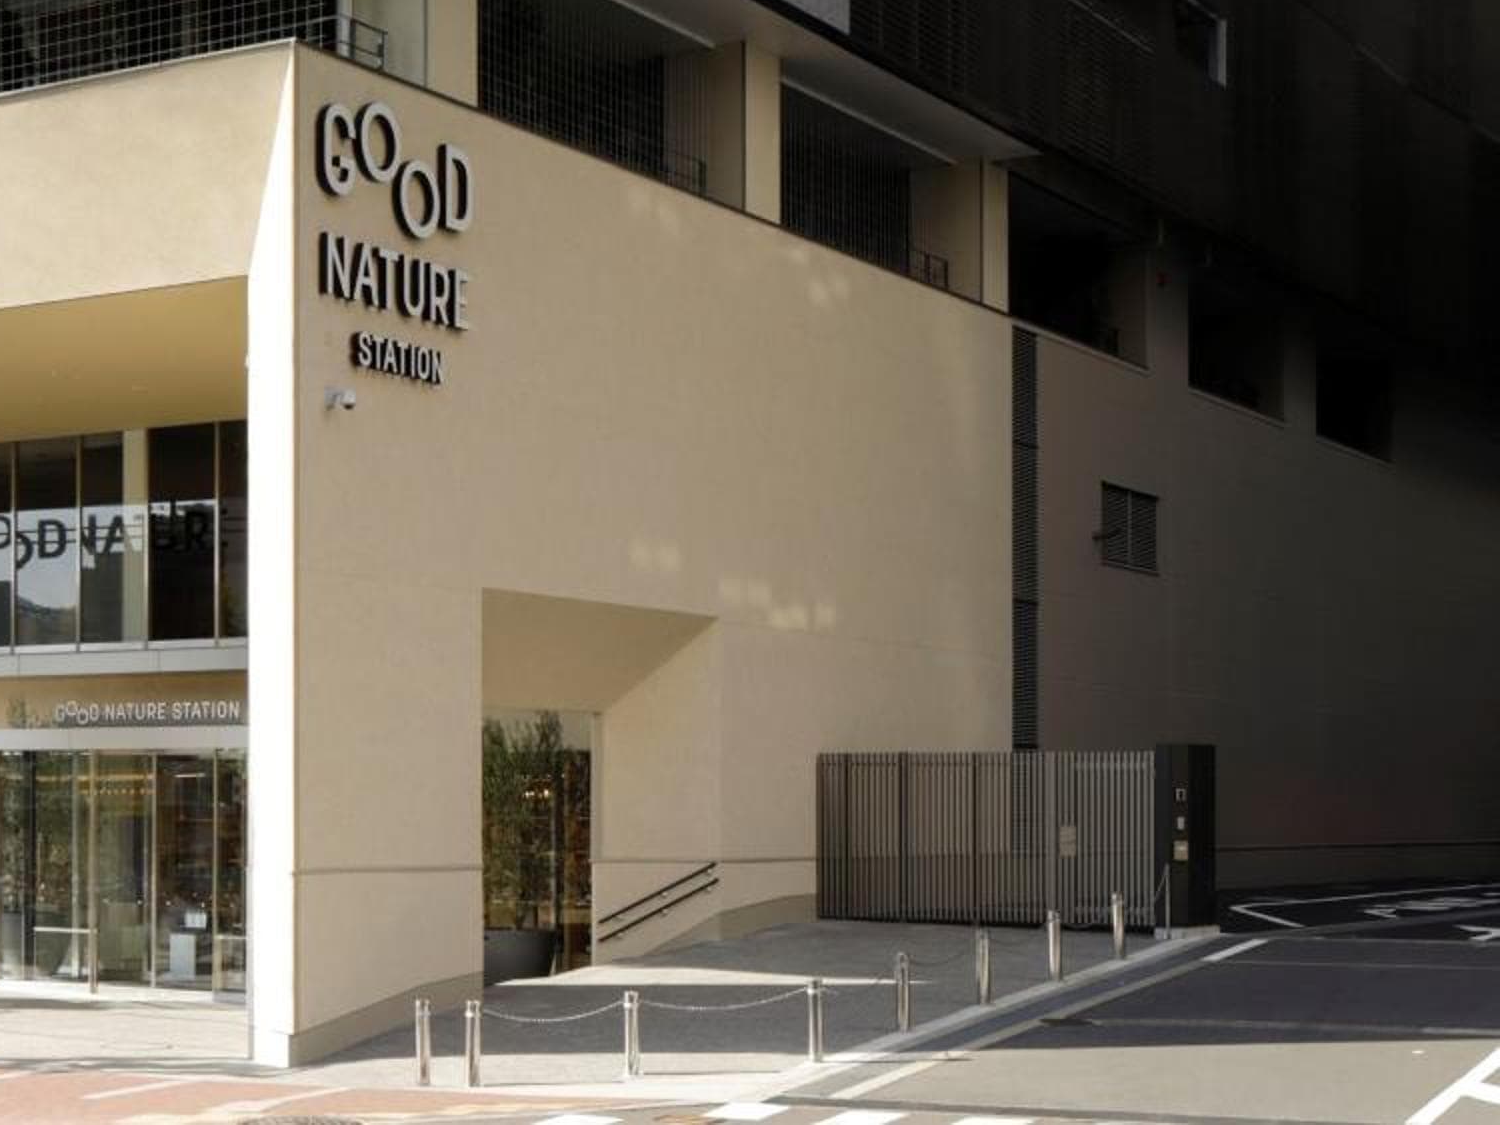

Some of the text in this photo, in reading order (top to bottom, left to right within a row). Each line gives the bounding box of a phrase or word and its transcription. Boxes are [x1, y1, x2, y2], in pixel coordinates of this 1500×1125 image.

[317, 100, 474, 239] GOOD
[322, 231, 470, 331] NATURE
[354, 330, 445, 384] STATION
[55, 700, 241, 725] GOOD NATURE STATION
